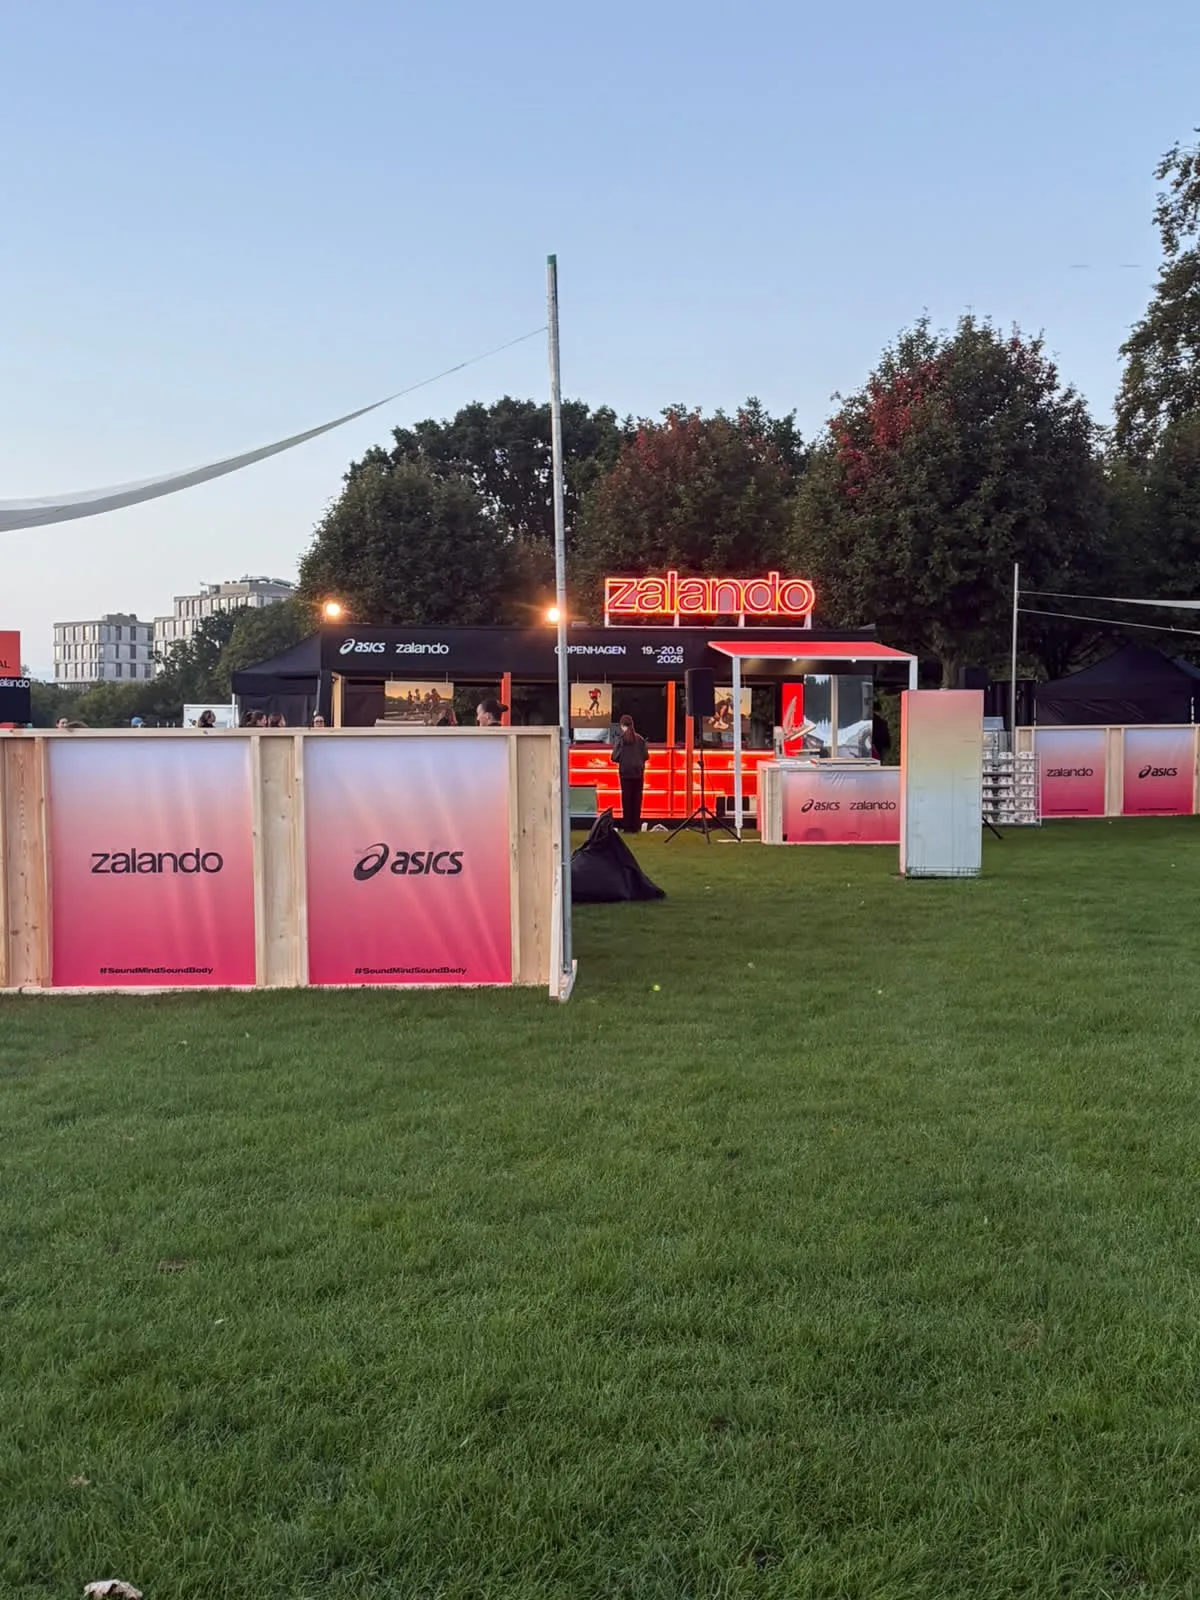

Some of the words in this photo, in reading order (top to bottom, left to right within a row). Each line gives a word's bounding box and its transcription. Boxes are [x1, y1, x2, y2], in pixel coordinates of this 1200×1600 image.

[605, 571, 815, 614] zalando
[354, 642, 386, 653] asics
[395, 642, 449, 654] zalando
[656, 655, 684, 664] 2026
[1047, 766, 1093, 777] zalando
[1151, 767, 1178, 777] asics
[814, 801, 840, 811] asics
[849, 800, 896, 811] zalando
[91, 847, 224, 874] zalando
[390, 851, 464, 875] asics
[100, 967, 214, 975] #SoundMindSoundBody
[354, 966, 467, 975] #SoundMindSoundBody
